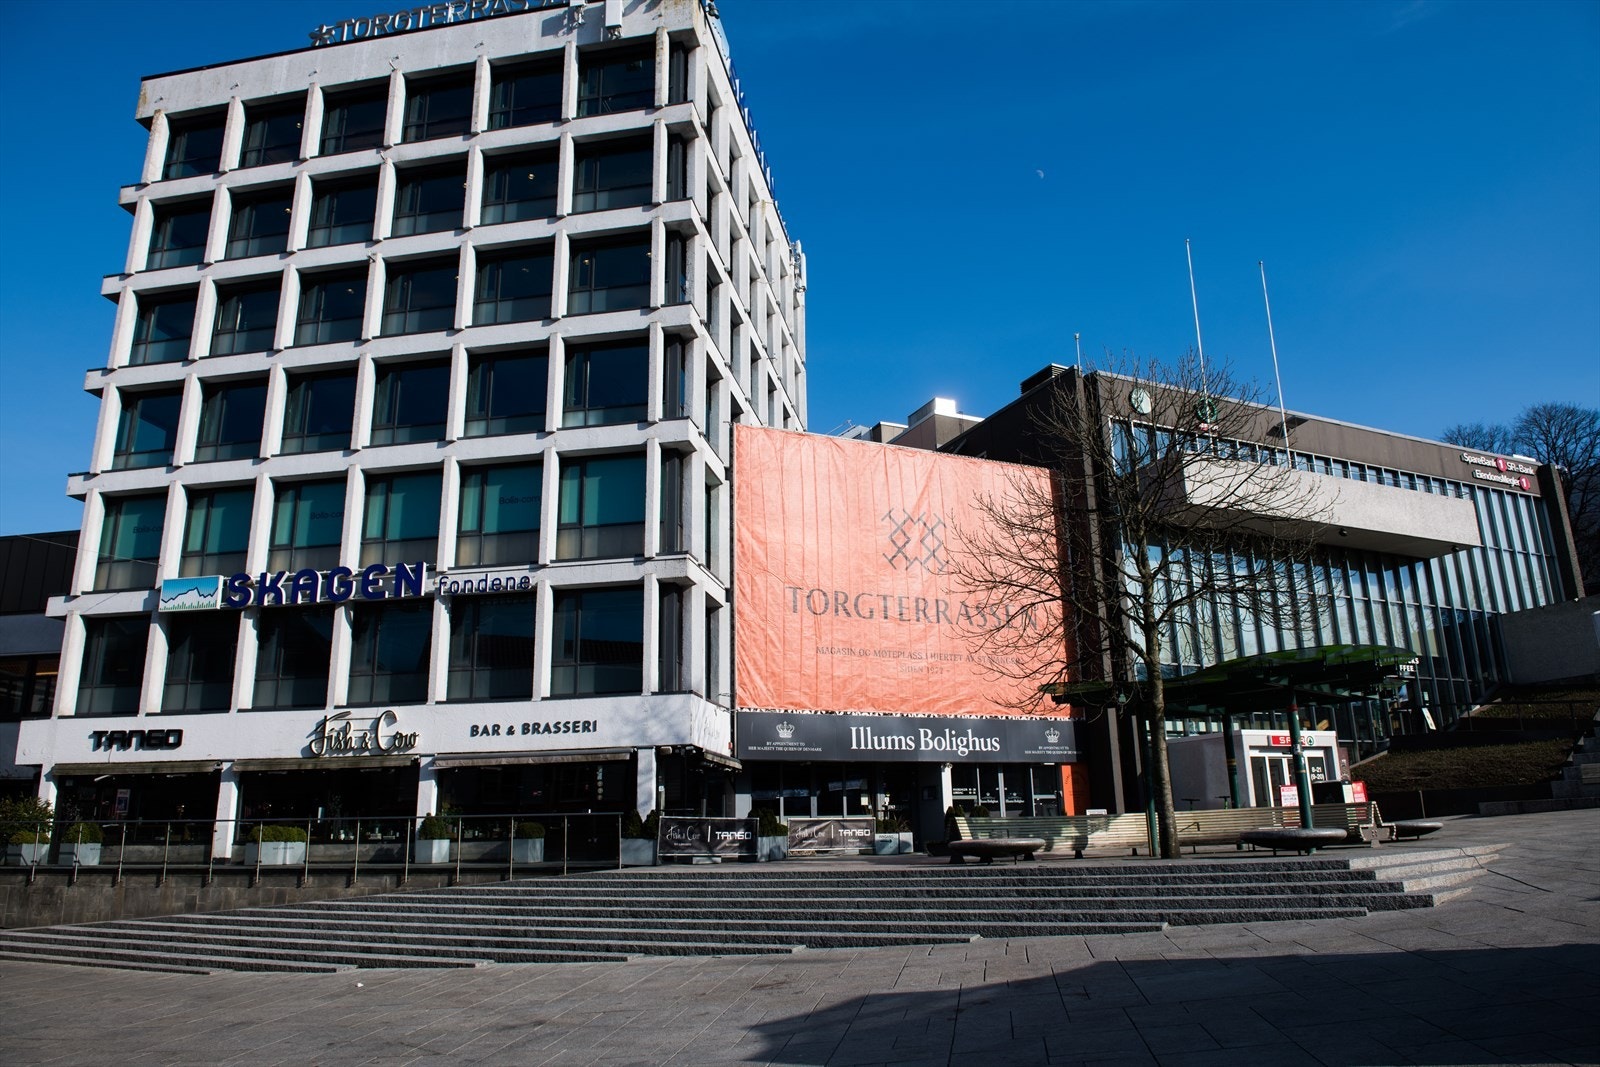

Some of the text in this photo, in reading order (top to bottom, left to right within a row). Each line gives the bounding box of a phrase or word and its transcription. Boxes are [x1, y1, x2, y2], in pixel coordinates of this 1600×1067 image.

[226, 561, 532, 608] SKAGEN fondene
[815, 646, 856, 656] MAGASIN
[858, 648, 871, 657] OG
[873, 649, 923, 660] MØTEPLASS
[926, 666, 944, 675] 1972
[309, 709, 420, 756] Fish & Cow
[469, 720, 598, 737] BAR & BRASSERI
[90, 730, 184, 750] TANGO
[850, 726, 1001, 756] Illums Bolighus
